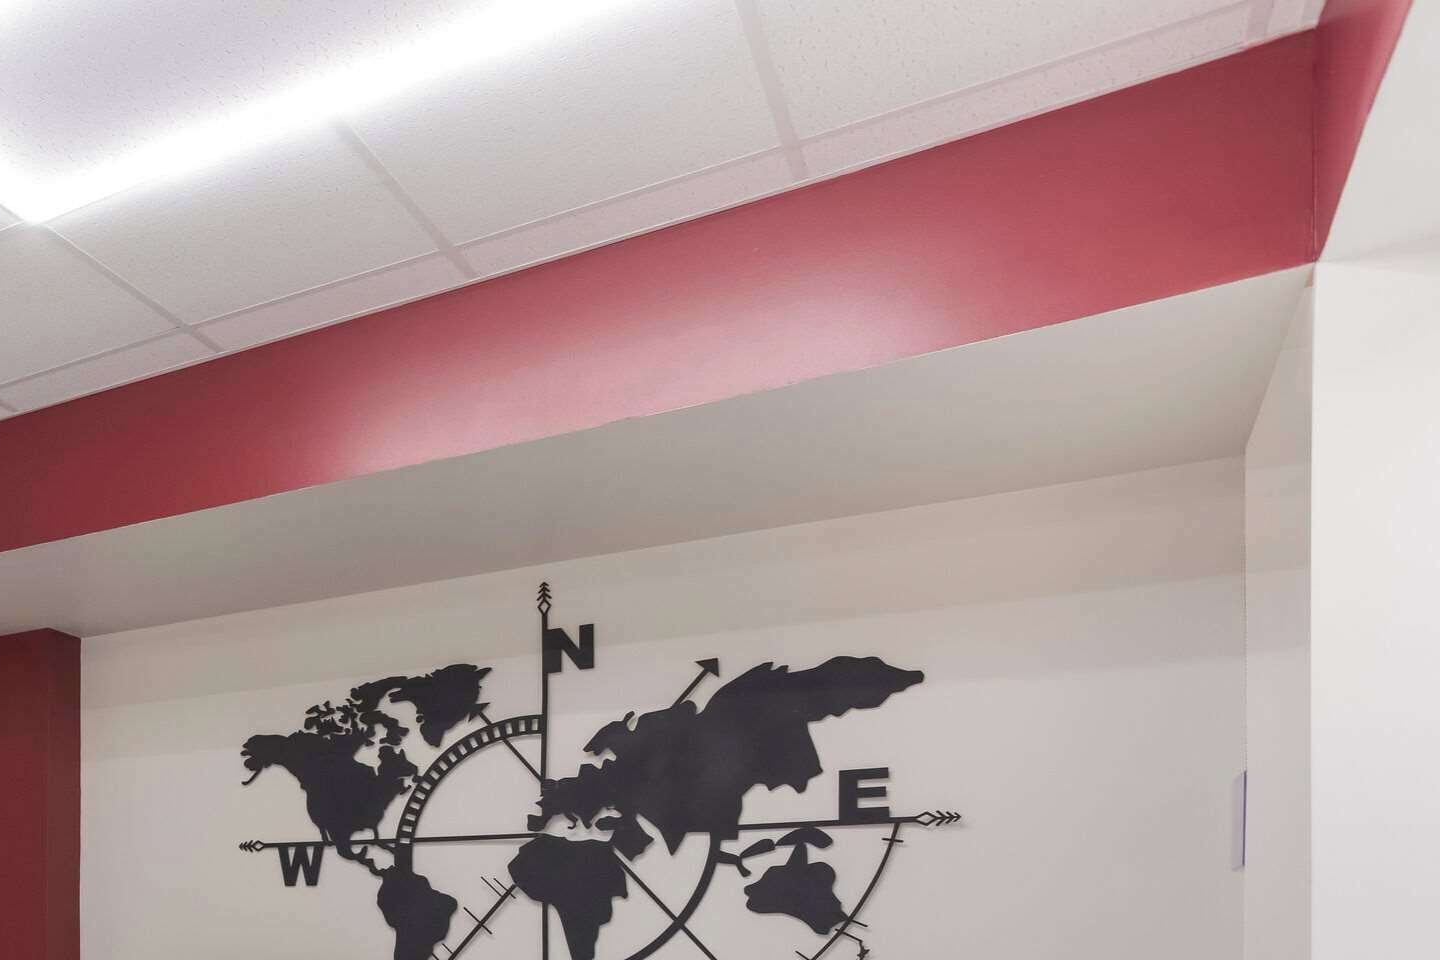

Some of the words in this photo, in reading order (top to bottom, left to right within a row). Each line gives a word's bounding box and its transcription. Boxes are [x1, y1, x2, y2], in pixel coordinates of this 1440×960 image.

[544, 624, 594, 673] N
[839, 767, 890, 824] E
[278, 842, 324, 887] W
